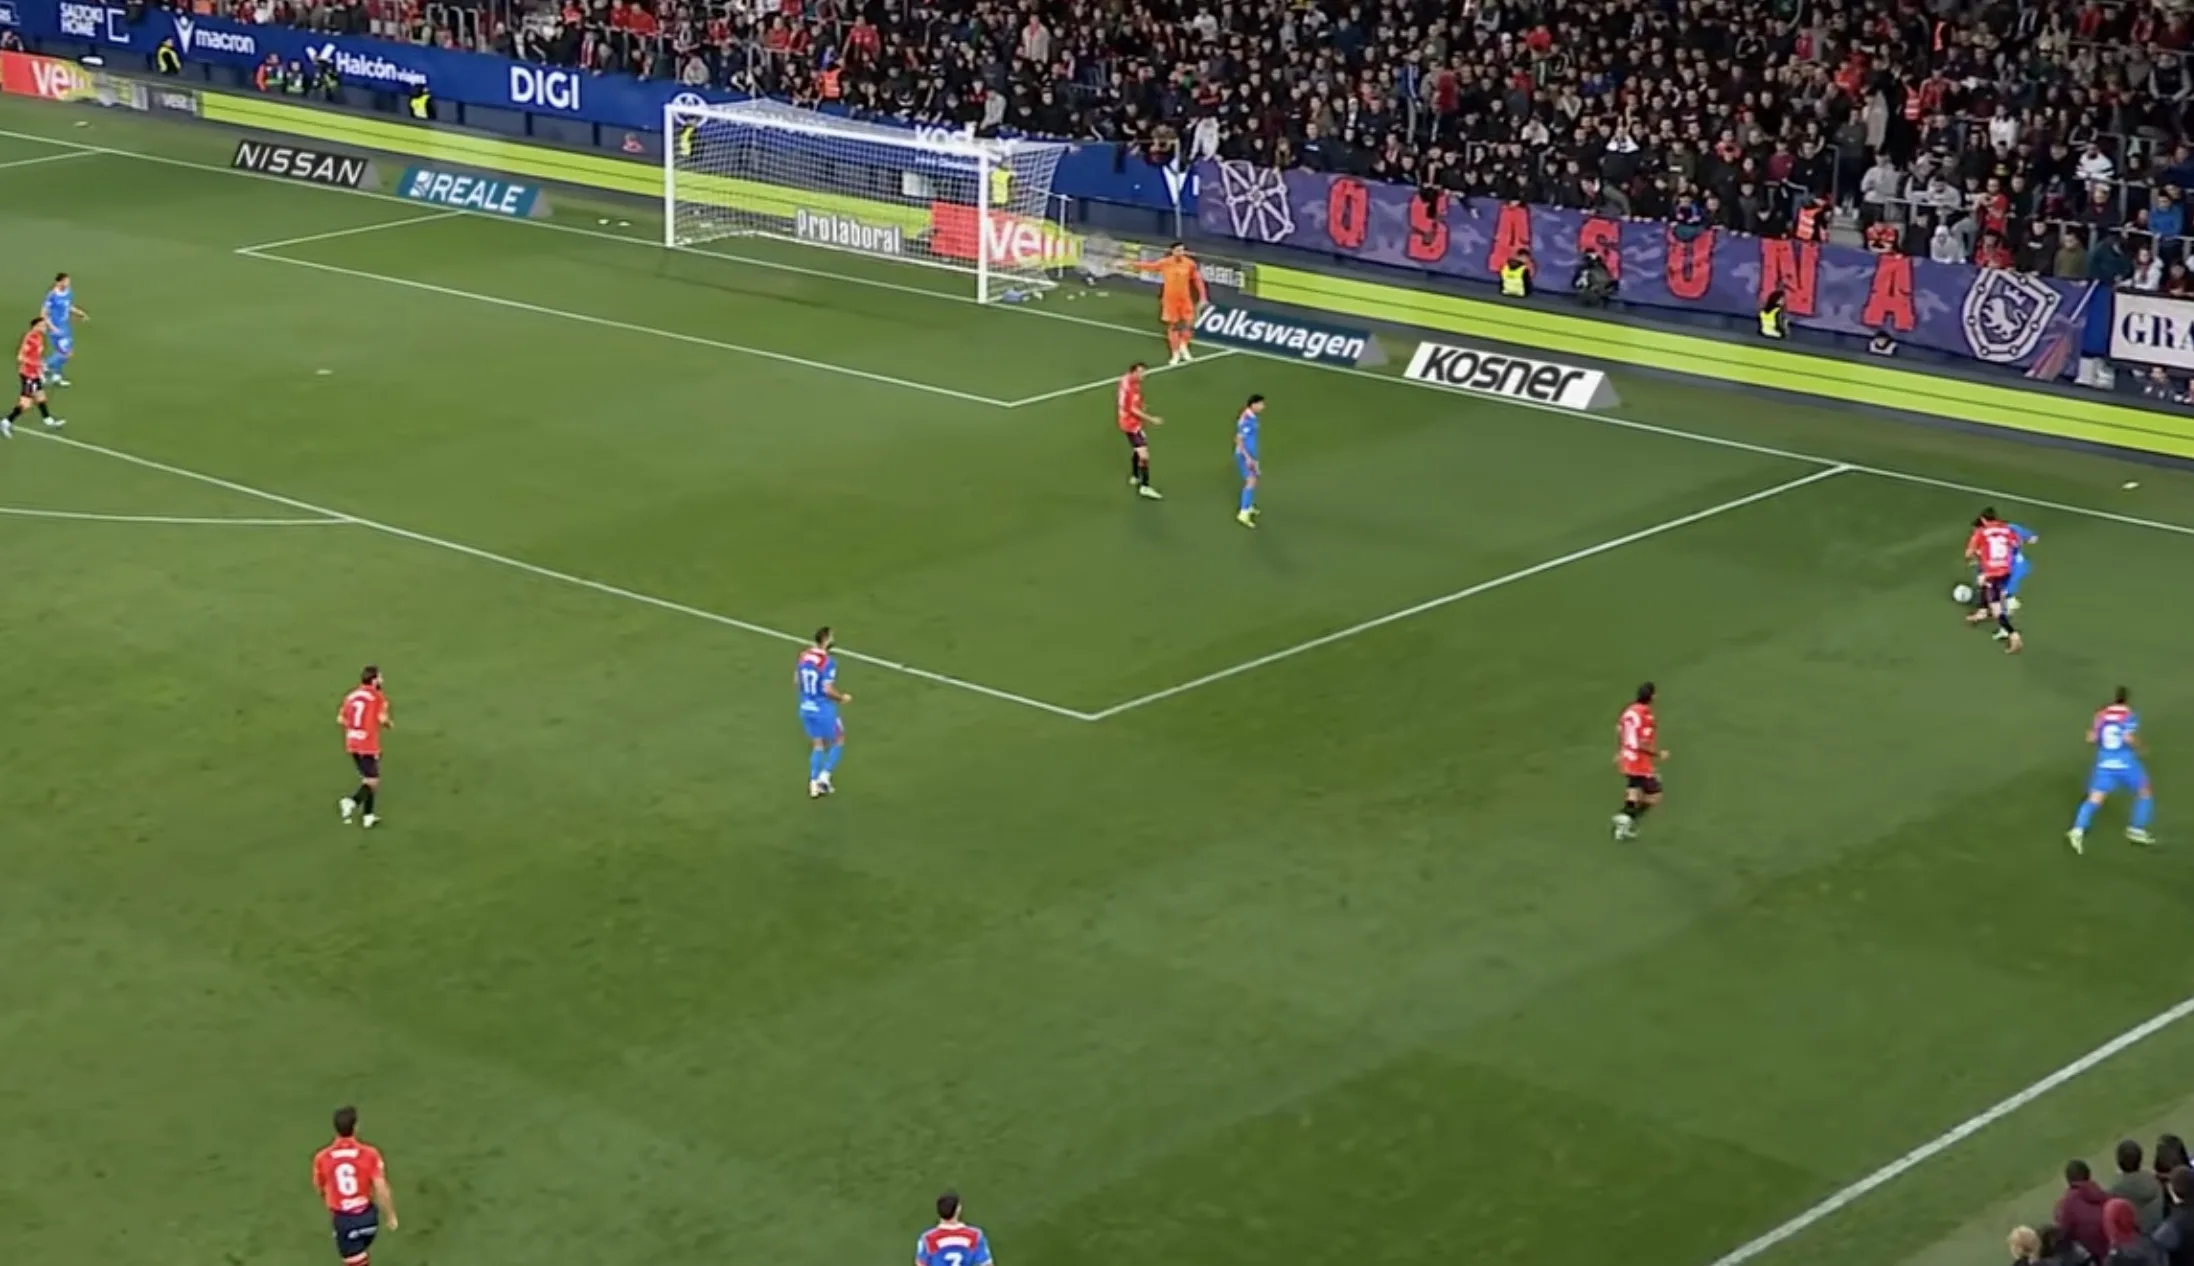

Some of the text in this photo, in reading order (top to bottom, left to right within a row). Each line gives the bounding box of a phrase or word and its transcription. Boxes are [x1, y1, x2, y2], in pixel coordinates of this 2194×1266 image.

[196, 29, 254, 53] macron
[336, 51, 397, 81] Halcón
[511, 66, 580, 111] DIGI
[236, 143, 363, 185] NISSAN
[430, 174, 525, 213] REALE
[797, 208, 900, 254] Prolaboral
[335, 1163, 358, 1196] 6
